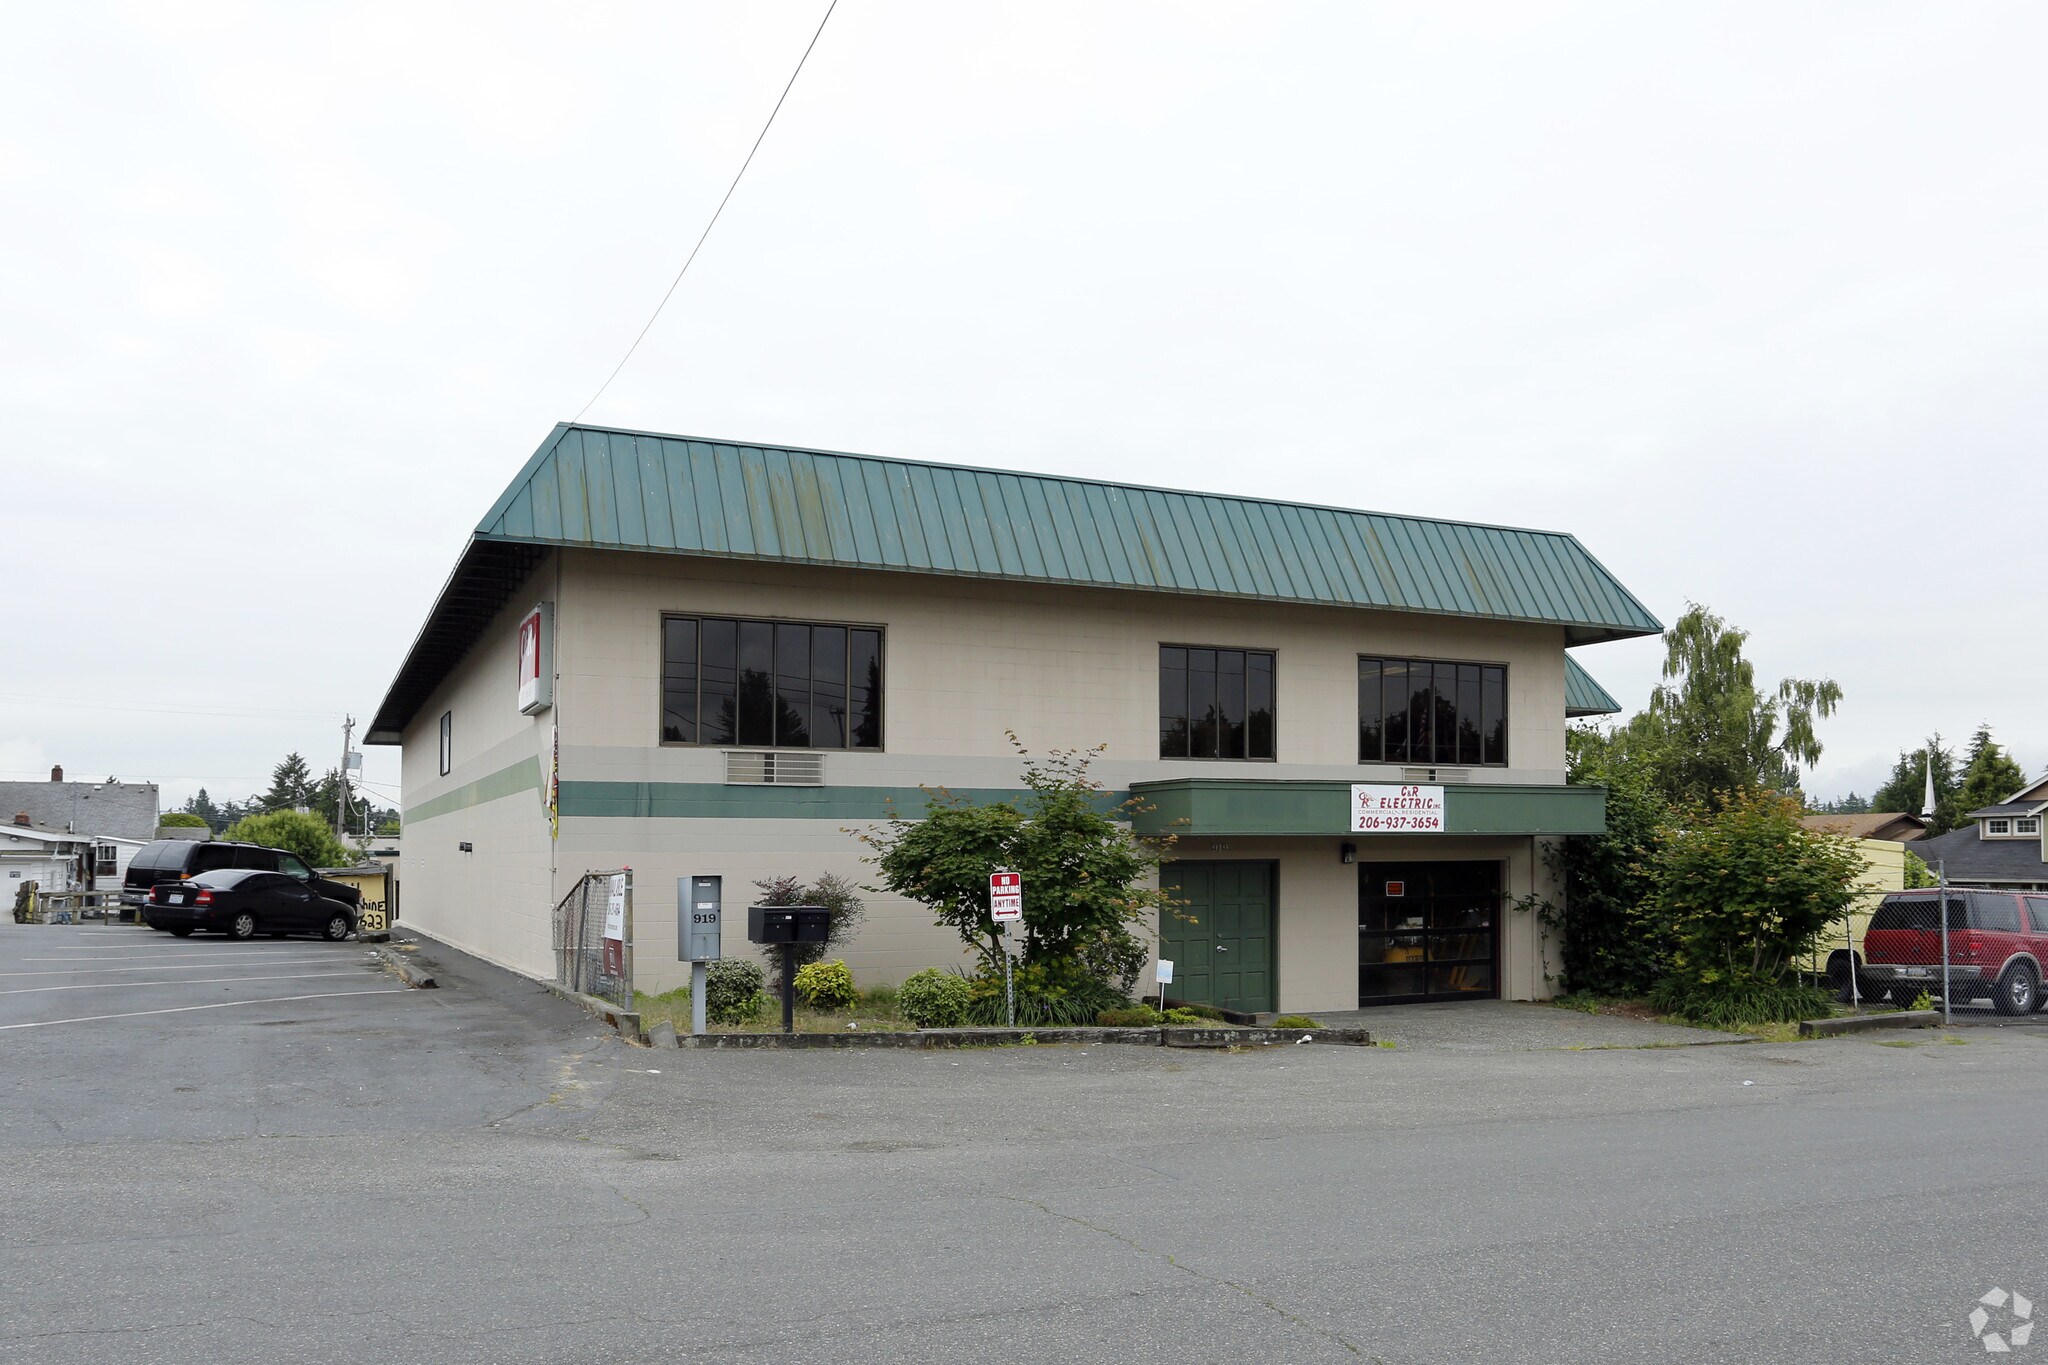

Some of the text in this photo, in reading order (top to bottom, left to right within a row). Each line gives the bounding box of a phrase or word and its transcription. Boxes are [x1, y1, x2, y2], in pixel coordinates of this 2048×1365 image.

[1401, 786, 1418, 797] C&R
[1380, 798, 1433, 808] ELECTRIC
[1359, 816, 1439, 829] 206-937-3654
[1001, 876, 1010, 885] NO
[992, 885, 1019, 895] PARKING
[994, 898, 1019, 908] ANYTIME
[693, 913, 716, 924] 919
